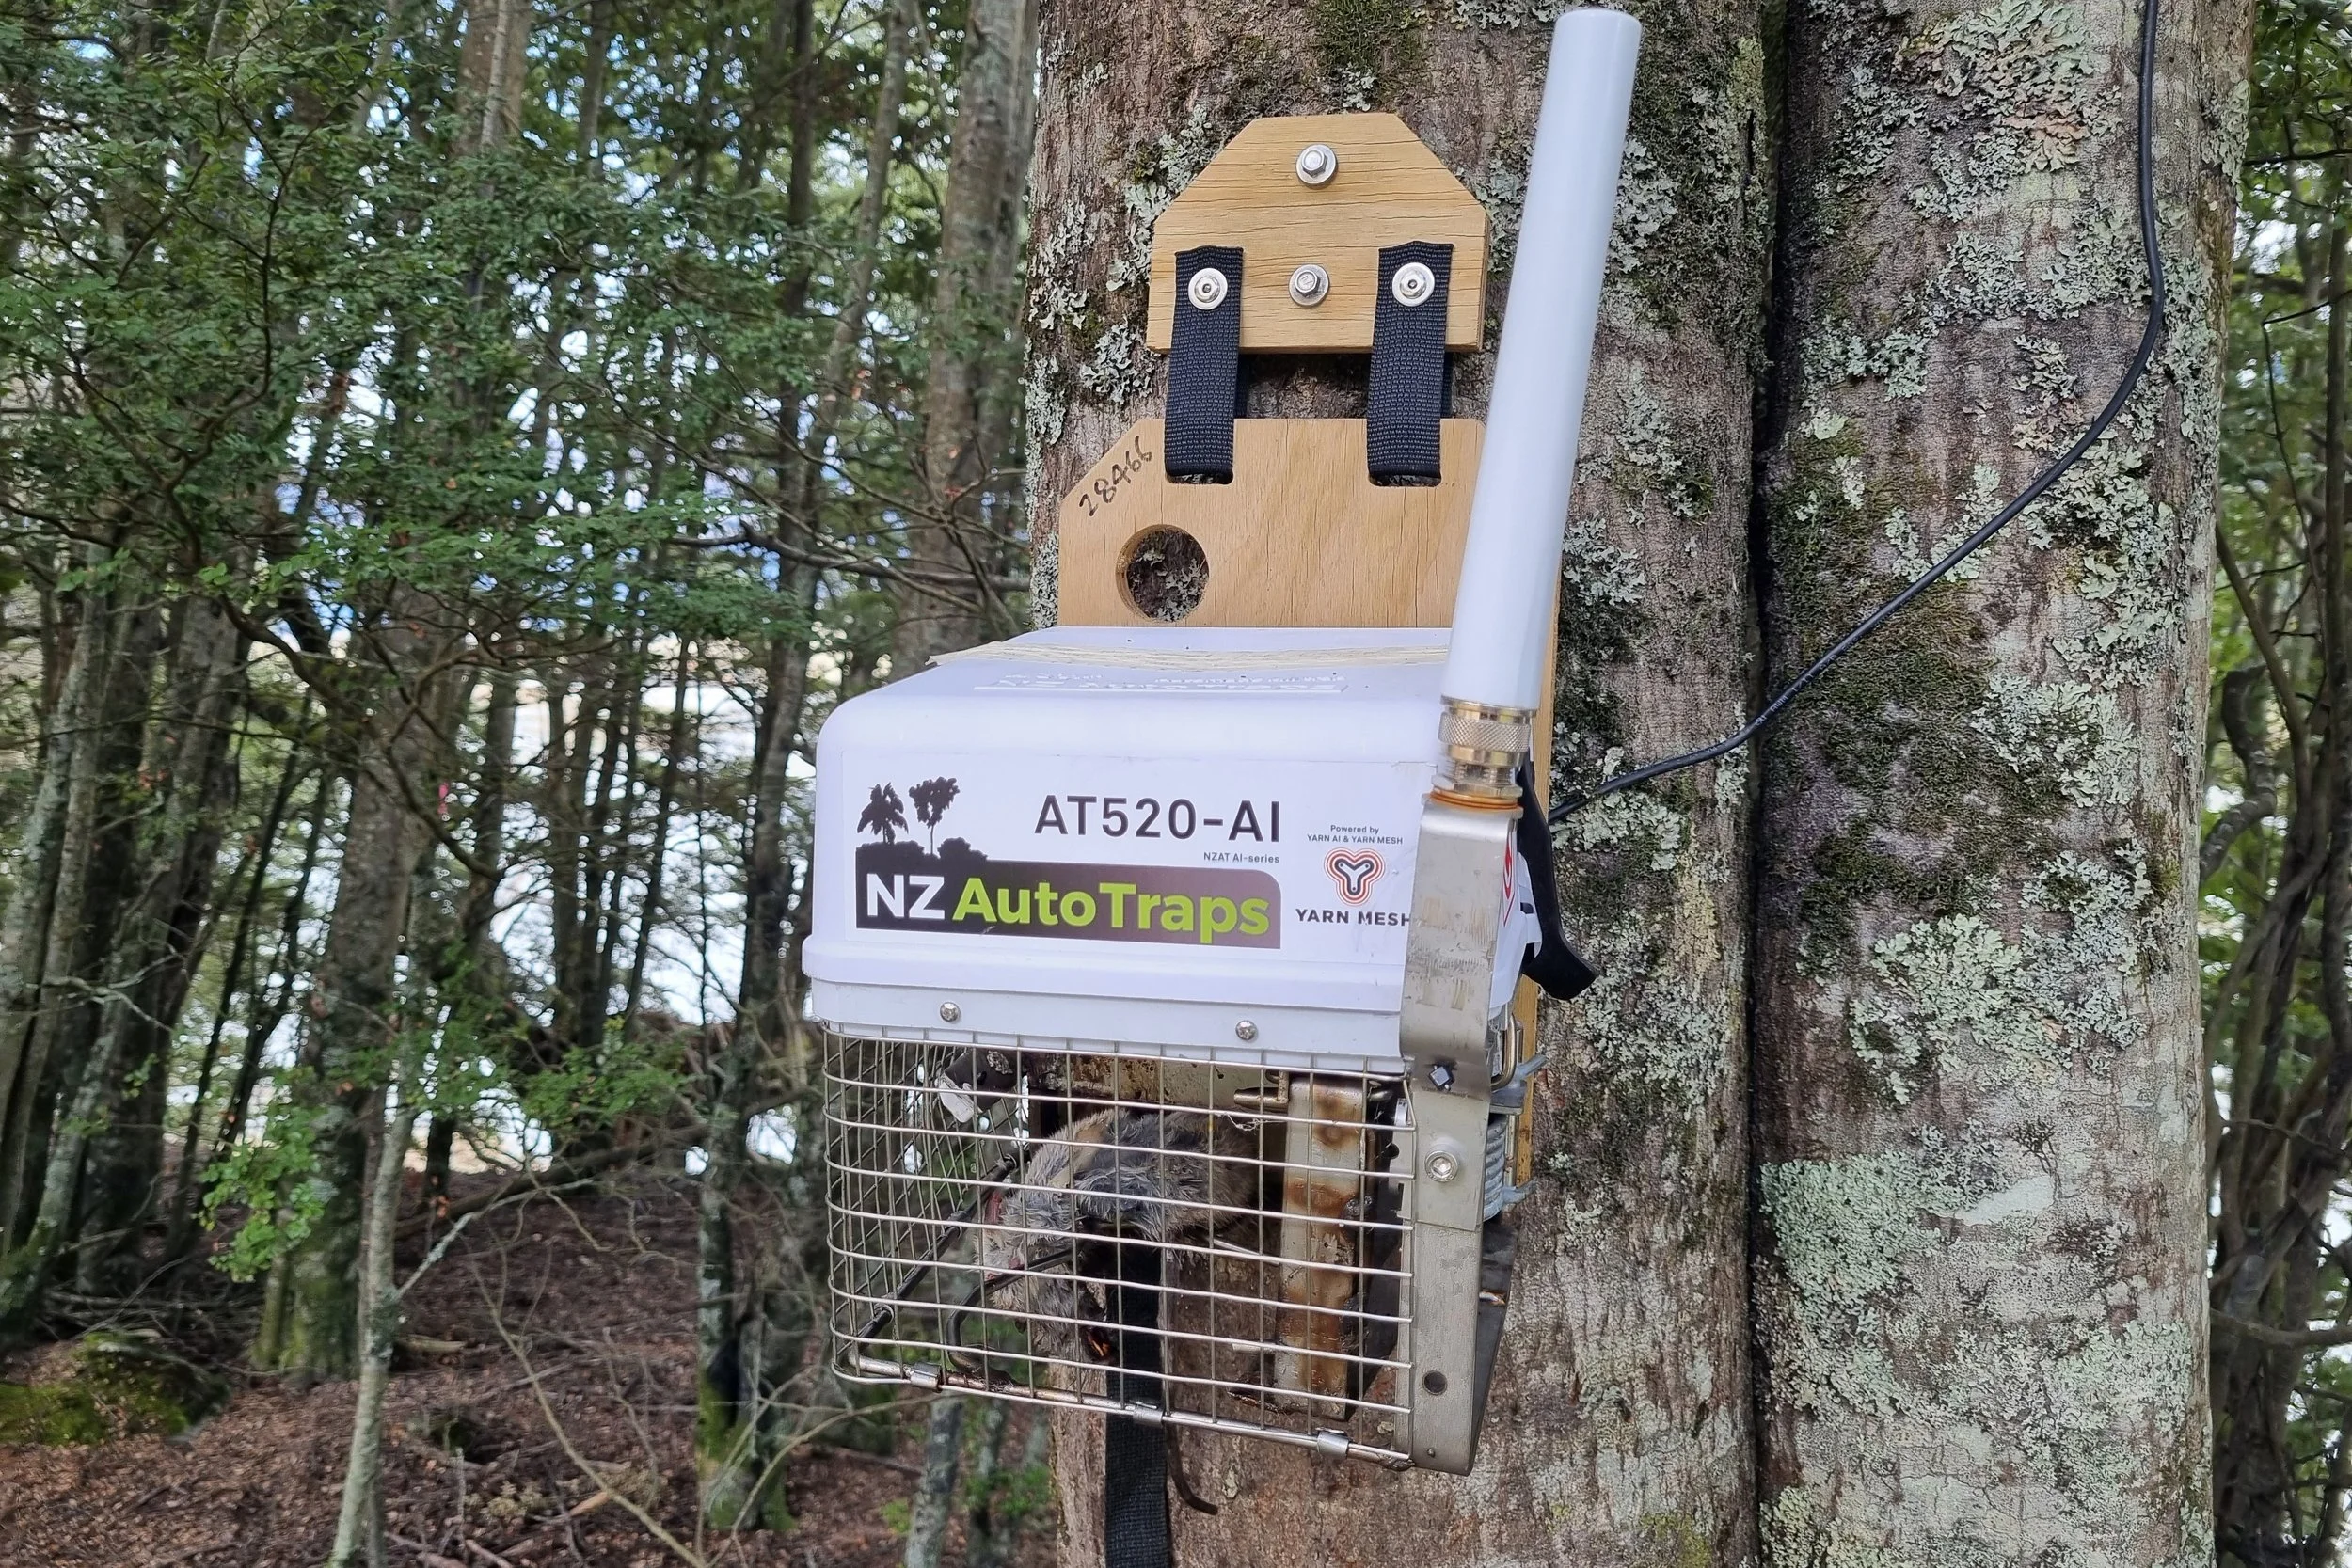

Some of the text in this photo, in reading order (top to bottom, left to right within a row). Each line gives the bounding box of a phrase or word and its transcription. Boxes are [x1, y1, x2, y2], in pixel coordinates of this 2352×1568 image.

[1079, 435, 1153, 517] 28466
[1034, 794, 1280, 843] AT520-AI
[1330, 825, 1379, 835] Powered by
[1307, 834, 1330, 843] YARN
[1352, 835, 1375, 844] YARN
[1376, 836, 1404, 845] MESH
[1203, 852, 1279, 863] NZAT AI-series
[1295, 908, 1411, 927] YARN MESH
